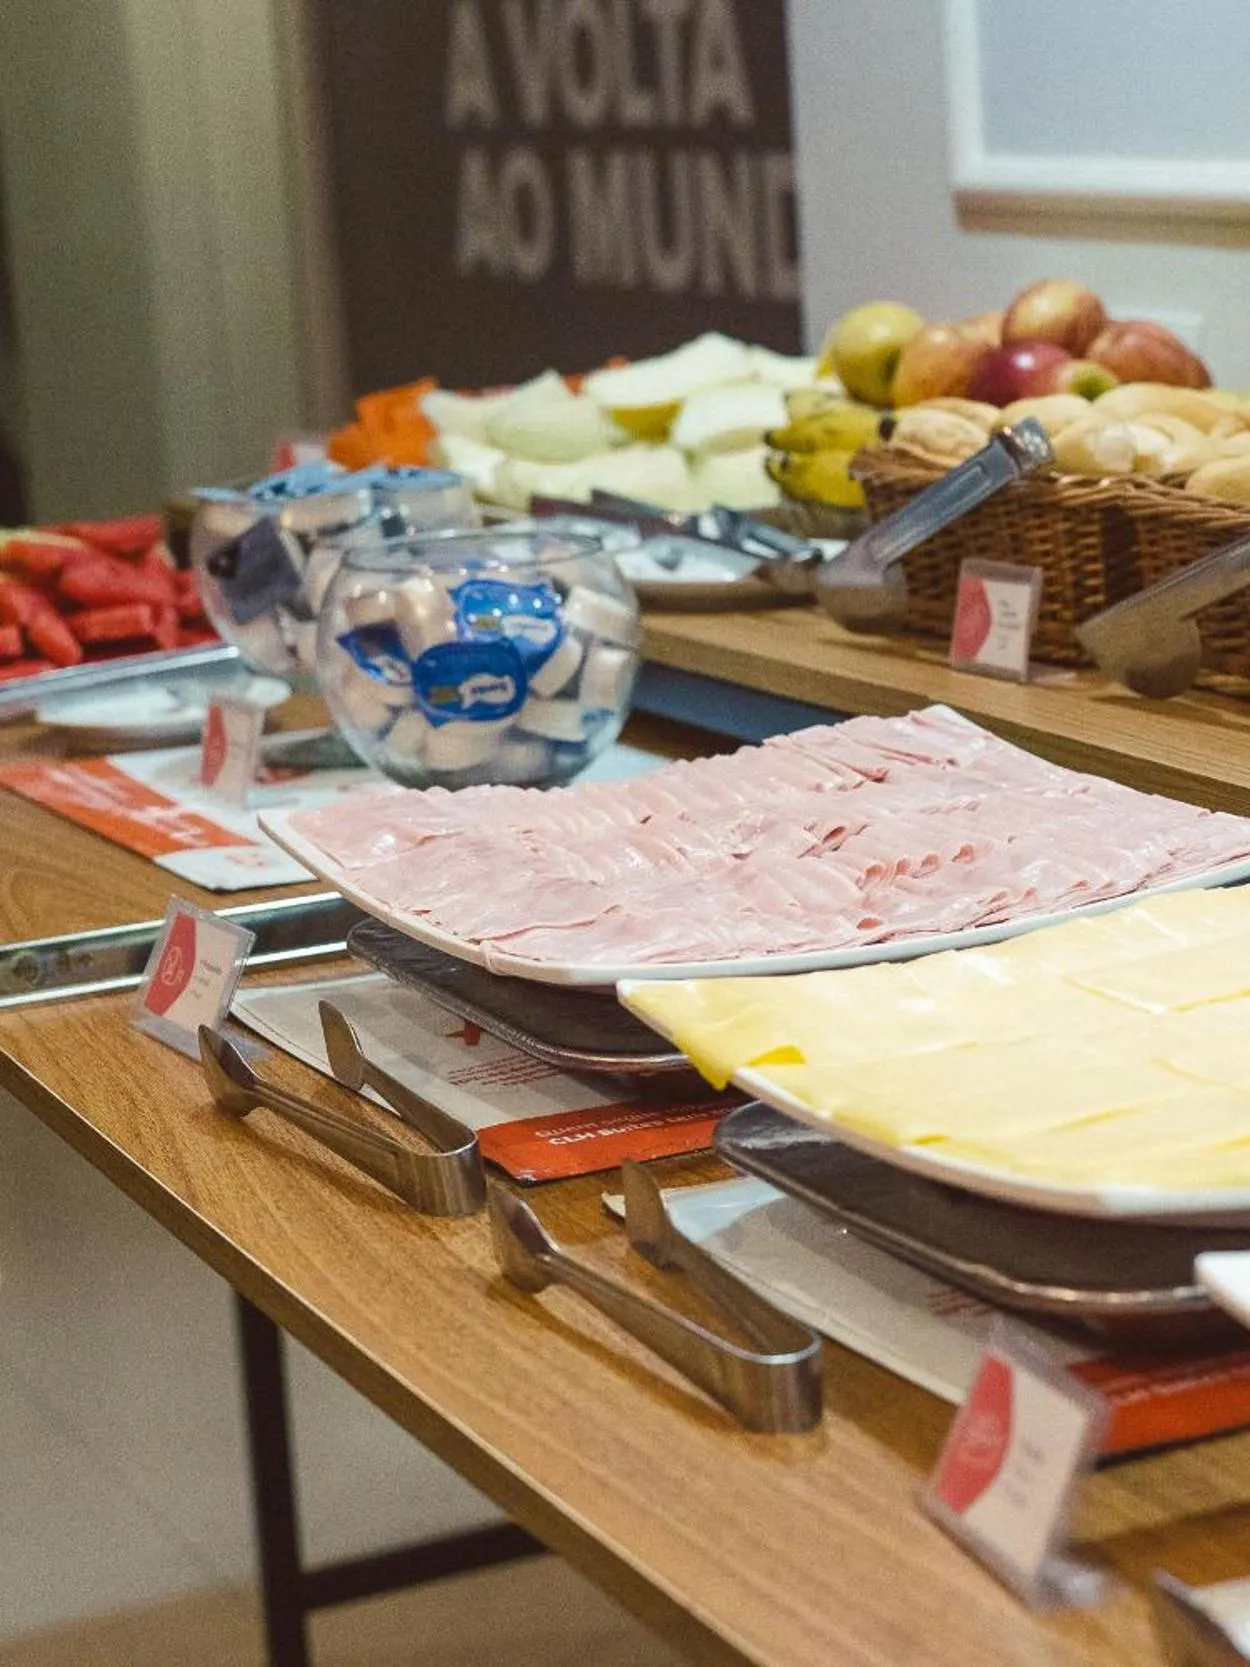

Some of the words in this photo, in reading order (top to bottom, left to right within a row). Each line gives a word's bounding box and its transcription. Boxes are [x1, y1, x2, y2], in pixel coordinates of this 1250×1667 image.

[446, 0, 497, 127] A
[504, 0, 752, 127] VOLTA
[457, 148, 554, 282] AO
